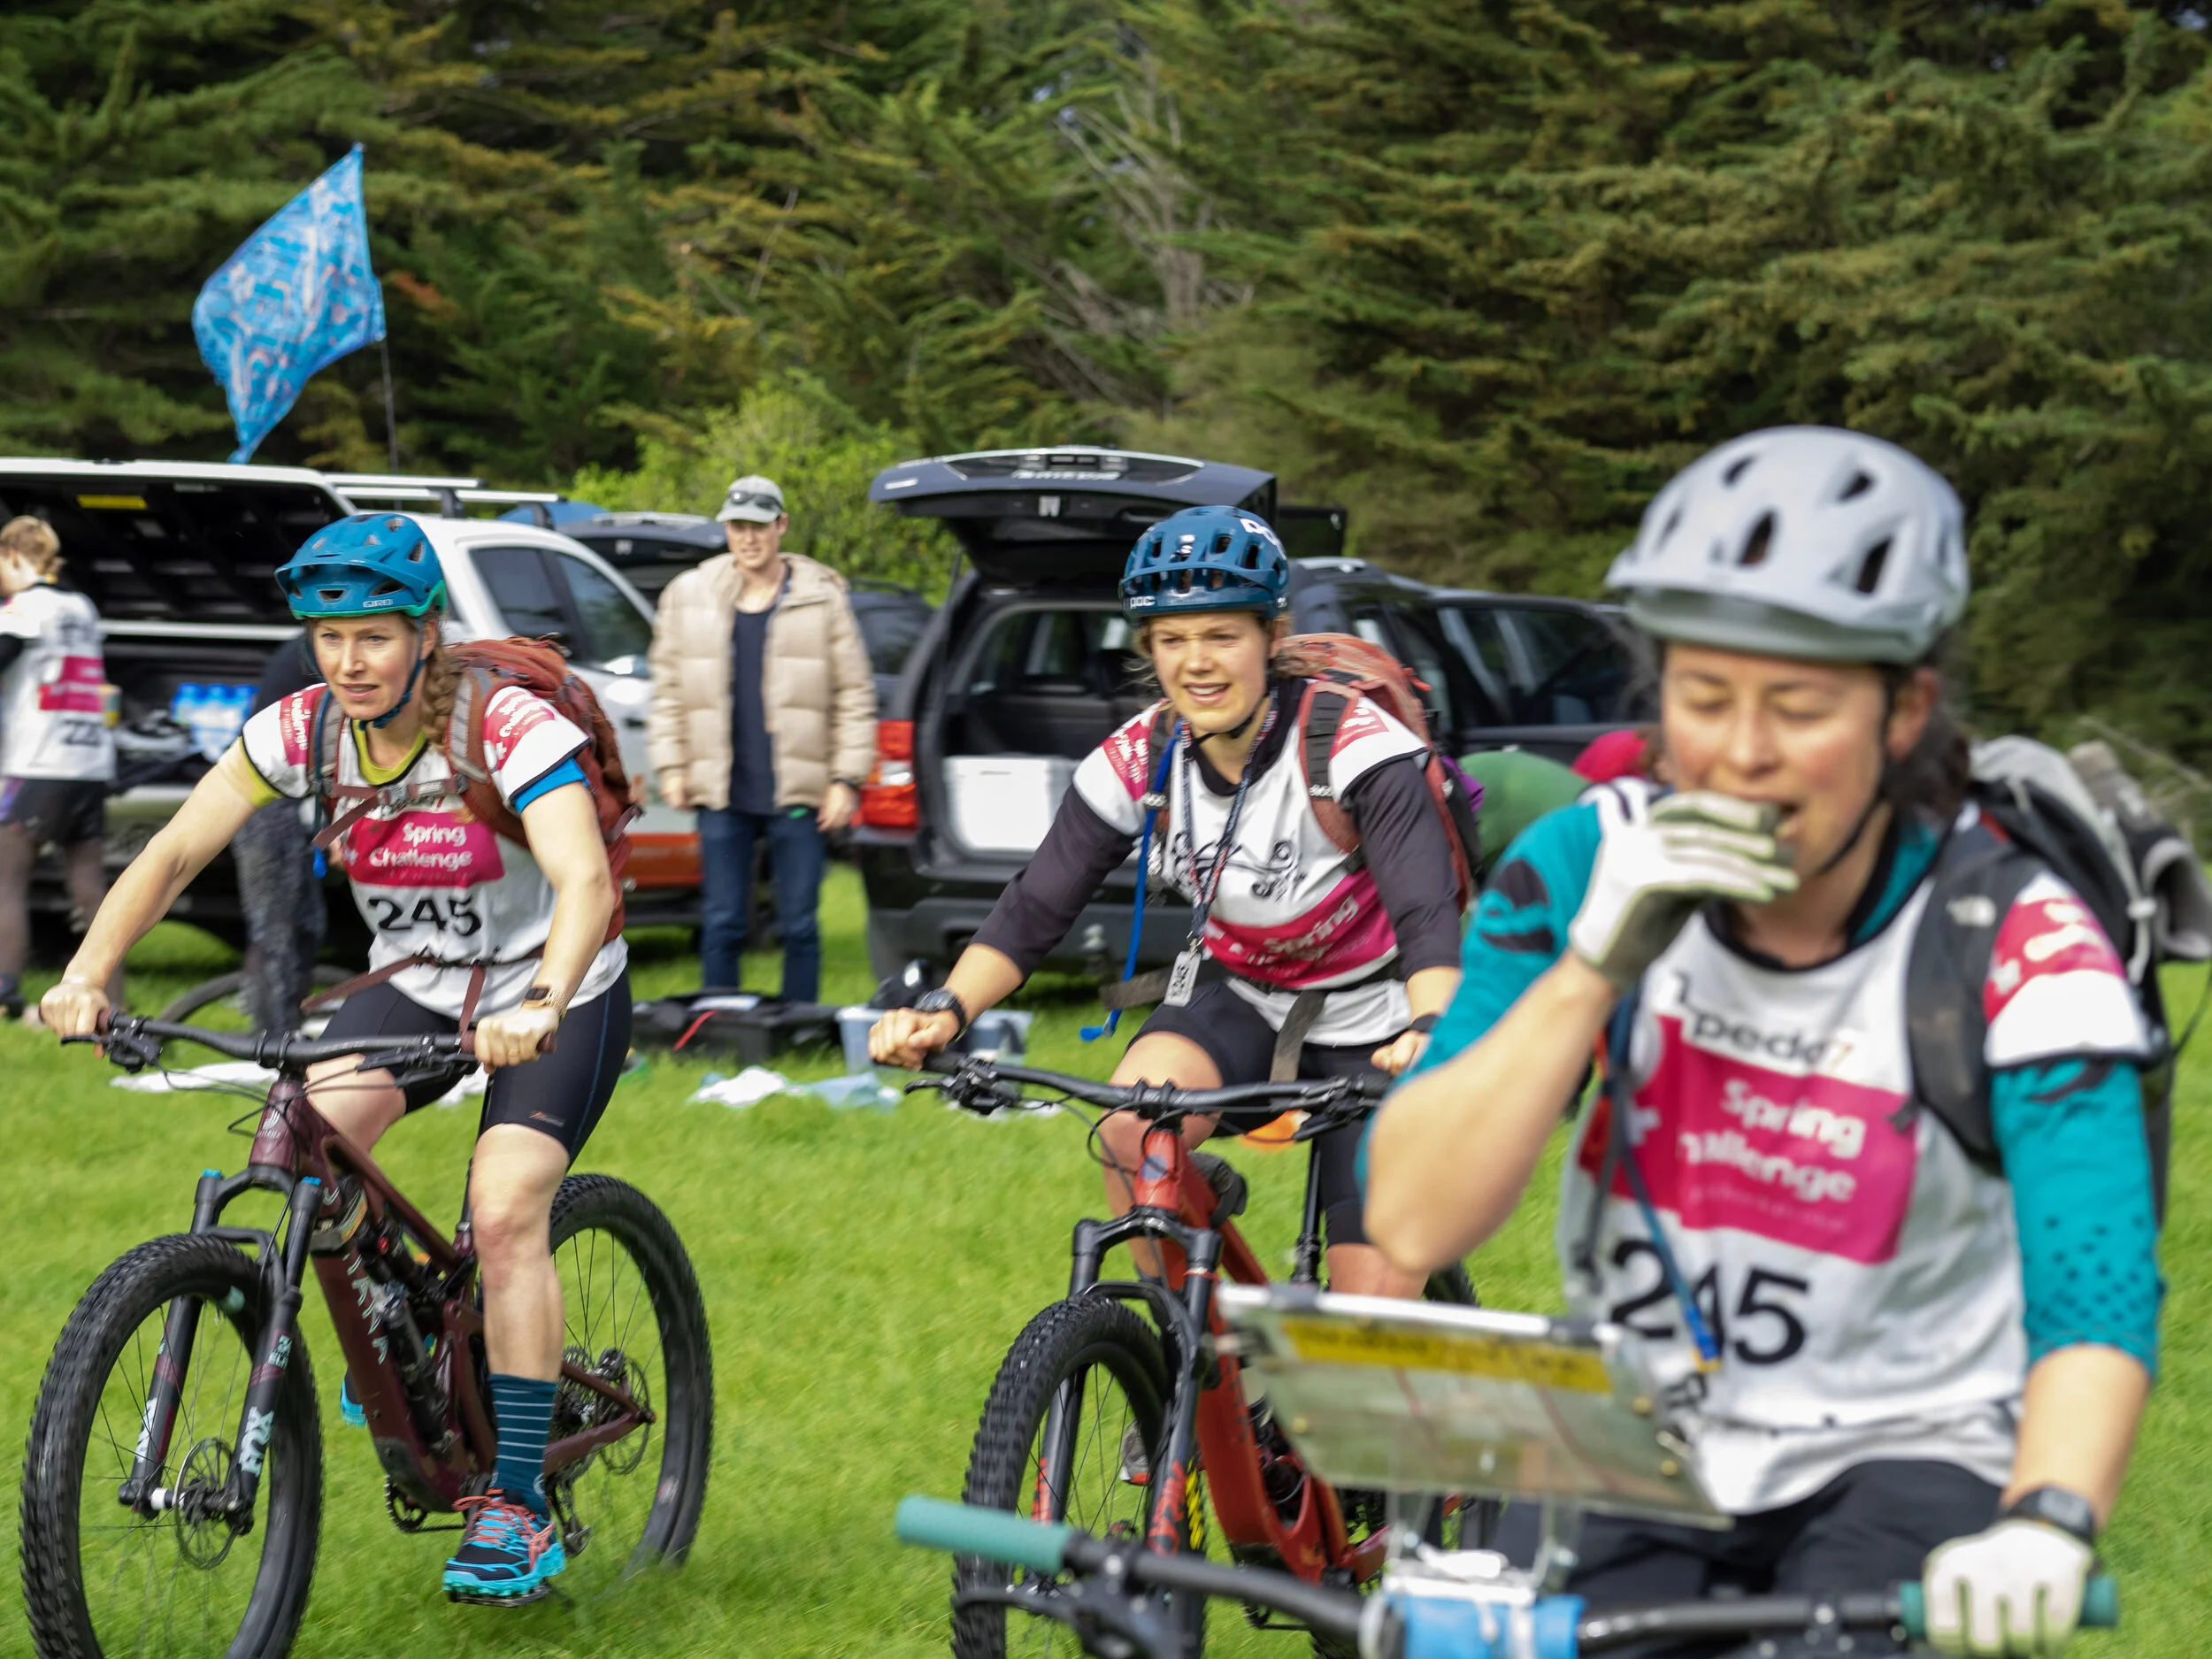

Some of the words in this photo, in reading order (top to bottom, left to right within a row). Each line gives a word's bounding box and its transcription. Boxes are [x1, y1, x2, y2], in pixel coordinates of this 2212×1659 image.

[403, 822, 467, 848] Spring
[369, 847, 473, 872] Challenge
[367, 894, 483, 938] 245
[1723, 1079, 1866, 1160] Spring
[239, 1406, 274, 1477] FOX
